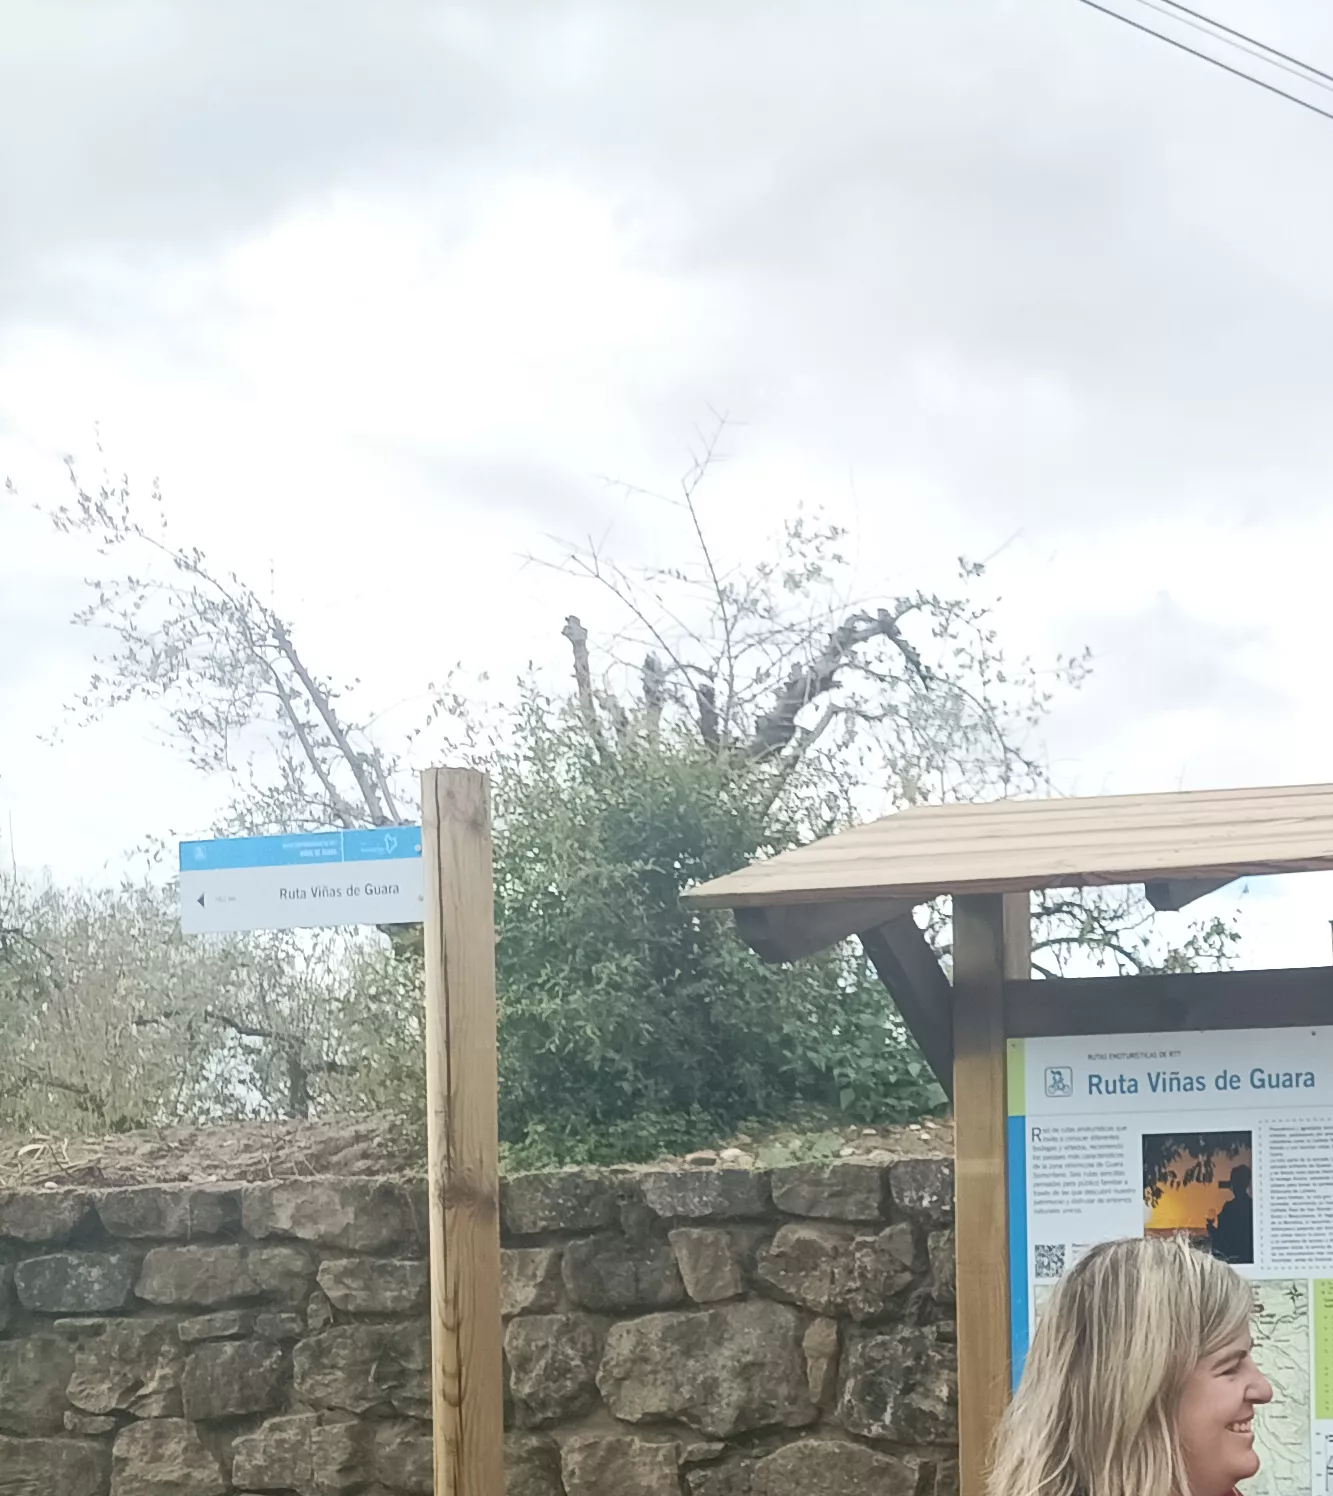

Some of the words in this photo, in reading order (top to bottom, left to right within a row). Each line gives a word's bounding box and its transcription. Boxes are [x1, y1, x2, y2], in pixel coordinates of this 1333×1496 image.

[279, 886, 307, 901] Ruta
[310, 885, 343, 899] Viñas
[346, 884, 361, 897] de
[364, 882, 400, 896] Guara
[1087, 1074, 1139, 1095] Ruta
[1147, 1071, 1206, 1093] Viñas
[1214, 1069, 1242, 1090] de
[1249, 1067, 1316, 1089] Guara
